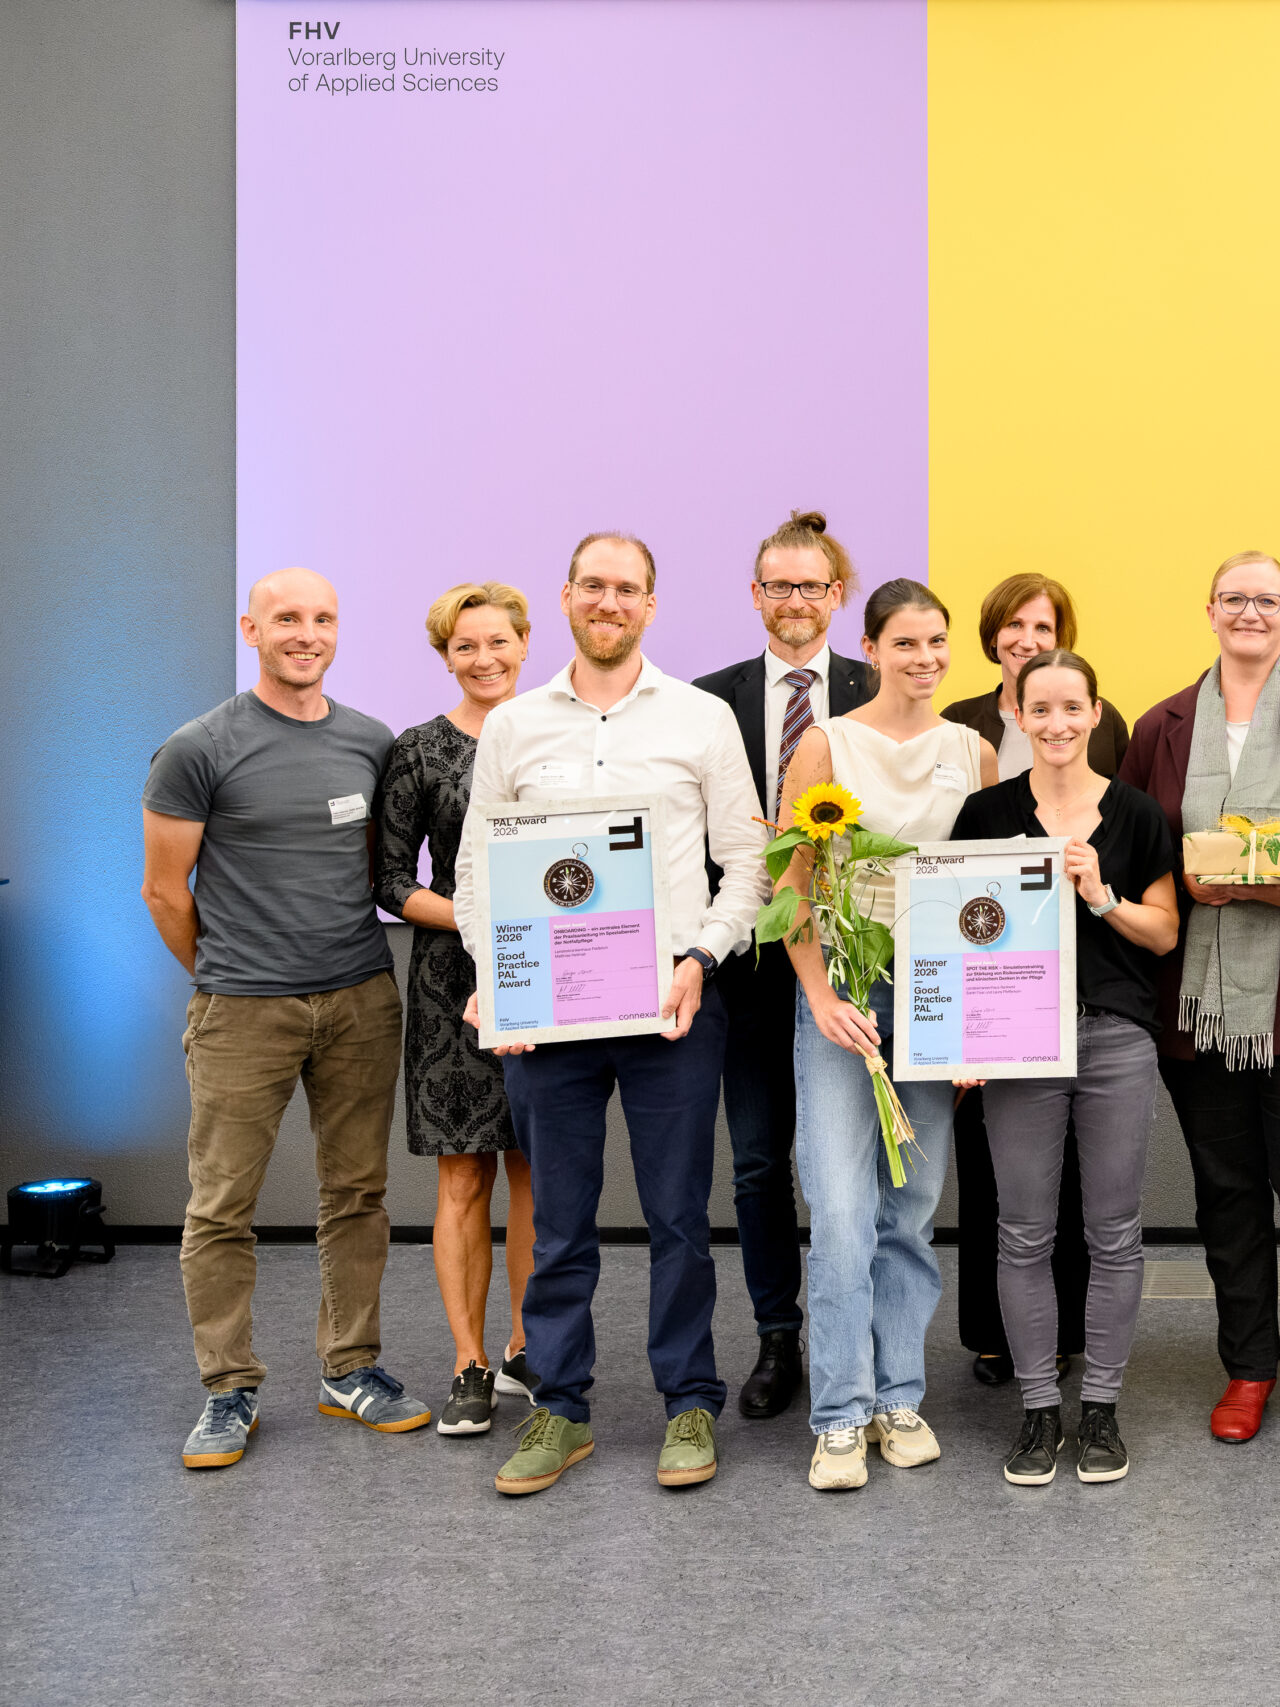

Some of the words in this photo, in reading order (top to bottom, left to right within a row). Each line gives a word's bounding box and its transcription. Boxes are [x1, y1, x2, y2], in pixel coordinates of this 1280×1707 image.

[289, 22, 341, 39] FHV
[288, 48, 396, 71] Vorarlberg
[404, 48, 505, 70] University
[288, 74, 309, 92] of
[315, 73, 394, 96] Applied
[402, 73, 498, 92] Sciences
[493, 818, 512, 827] PAL
[515, 816, 547, 826] Award
[493, 827, 518, 836] 2026
[916, 857, 933, 865] PAL
[936, 856, 965, 864] Award
[916, 866, 938, 874] 2026
[496, 924, 532, 934] Winner
[496, 933, 522, 943] 2026
[497, 951, 525, 961] Good
[497, 960, 540, 970] Practice
[914, 959, 947, 967] Winner
[498, 971, 517, 980] PAL
[914, 968, 938, 976] 2026
[498, 979, 531, 989] Award
[914, 986, 939, 994] Good
[914, 995, 952, 1003] Practice
[914, 1005, 931, 1013] PAL
[618, 1011, 657, 1021] connexia
[914, 1013, 943, 1022] Award
[1022, 1055, 1058, 1063] connexia
